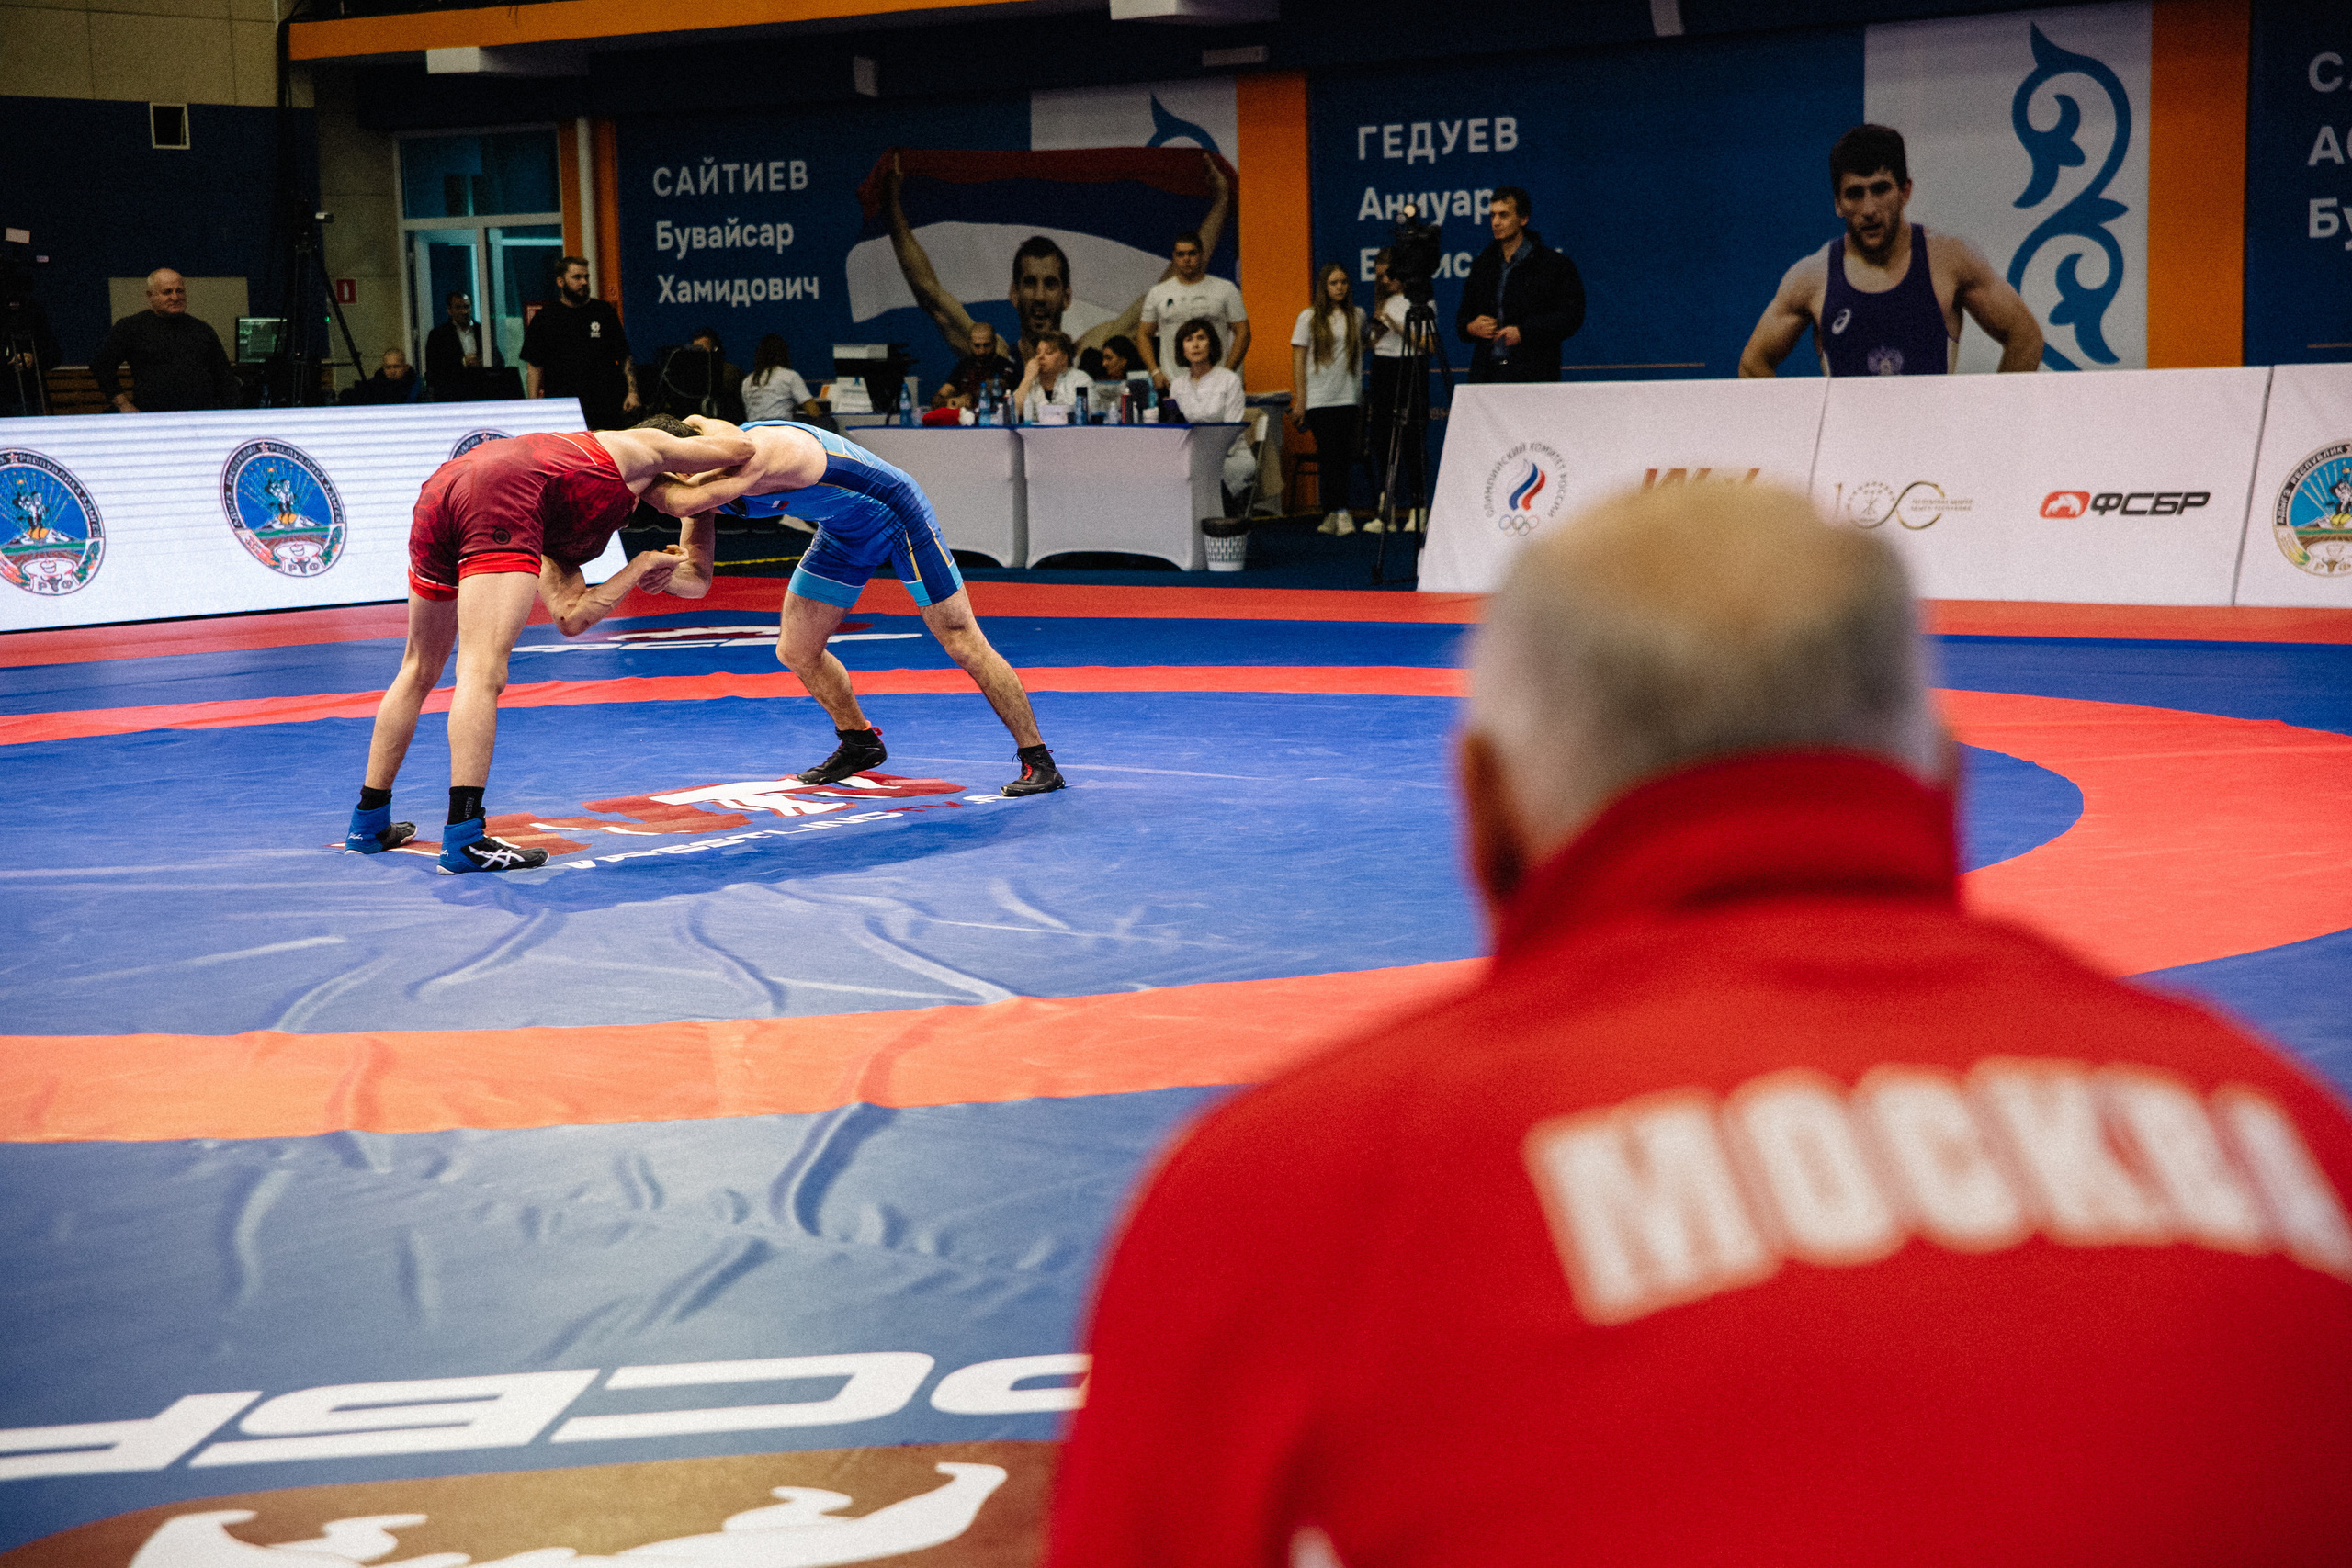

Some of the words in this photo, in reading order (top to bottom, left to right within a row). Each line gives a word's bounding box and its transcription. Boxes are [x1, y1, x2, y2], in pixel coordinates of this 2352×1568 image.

[1357, 115, 1519, 165] ГЕДУЕВ
[652, 156, 808, 197] САЙТИЕВ
[656, 217, 795, 261] Бувайсар
[657, 274, 820, 308] Хамидович
[1529, 442, 1566, 471] КОМИТЕТ
[1547, 473, 1566, 518] РОССИИ
[2090, 491, 2211, 516] ФСБР
